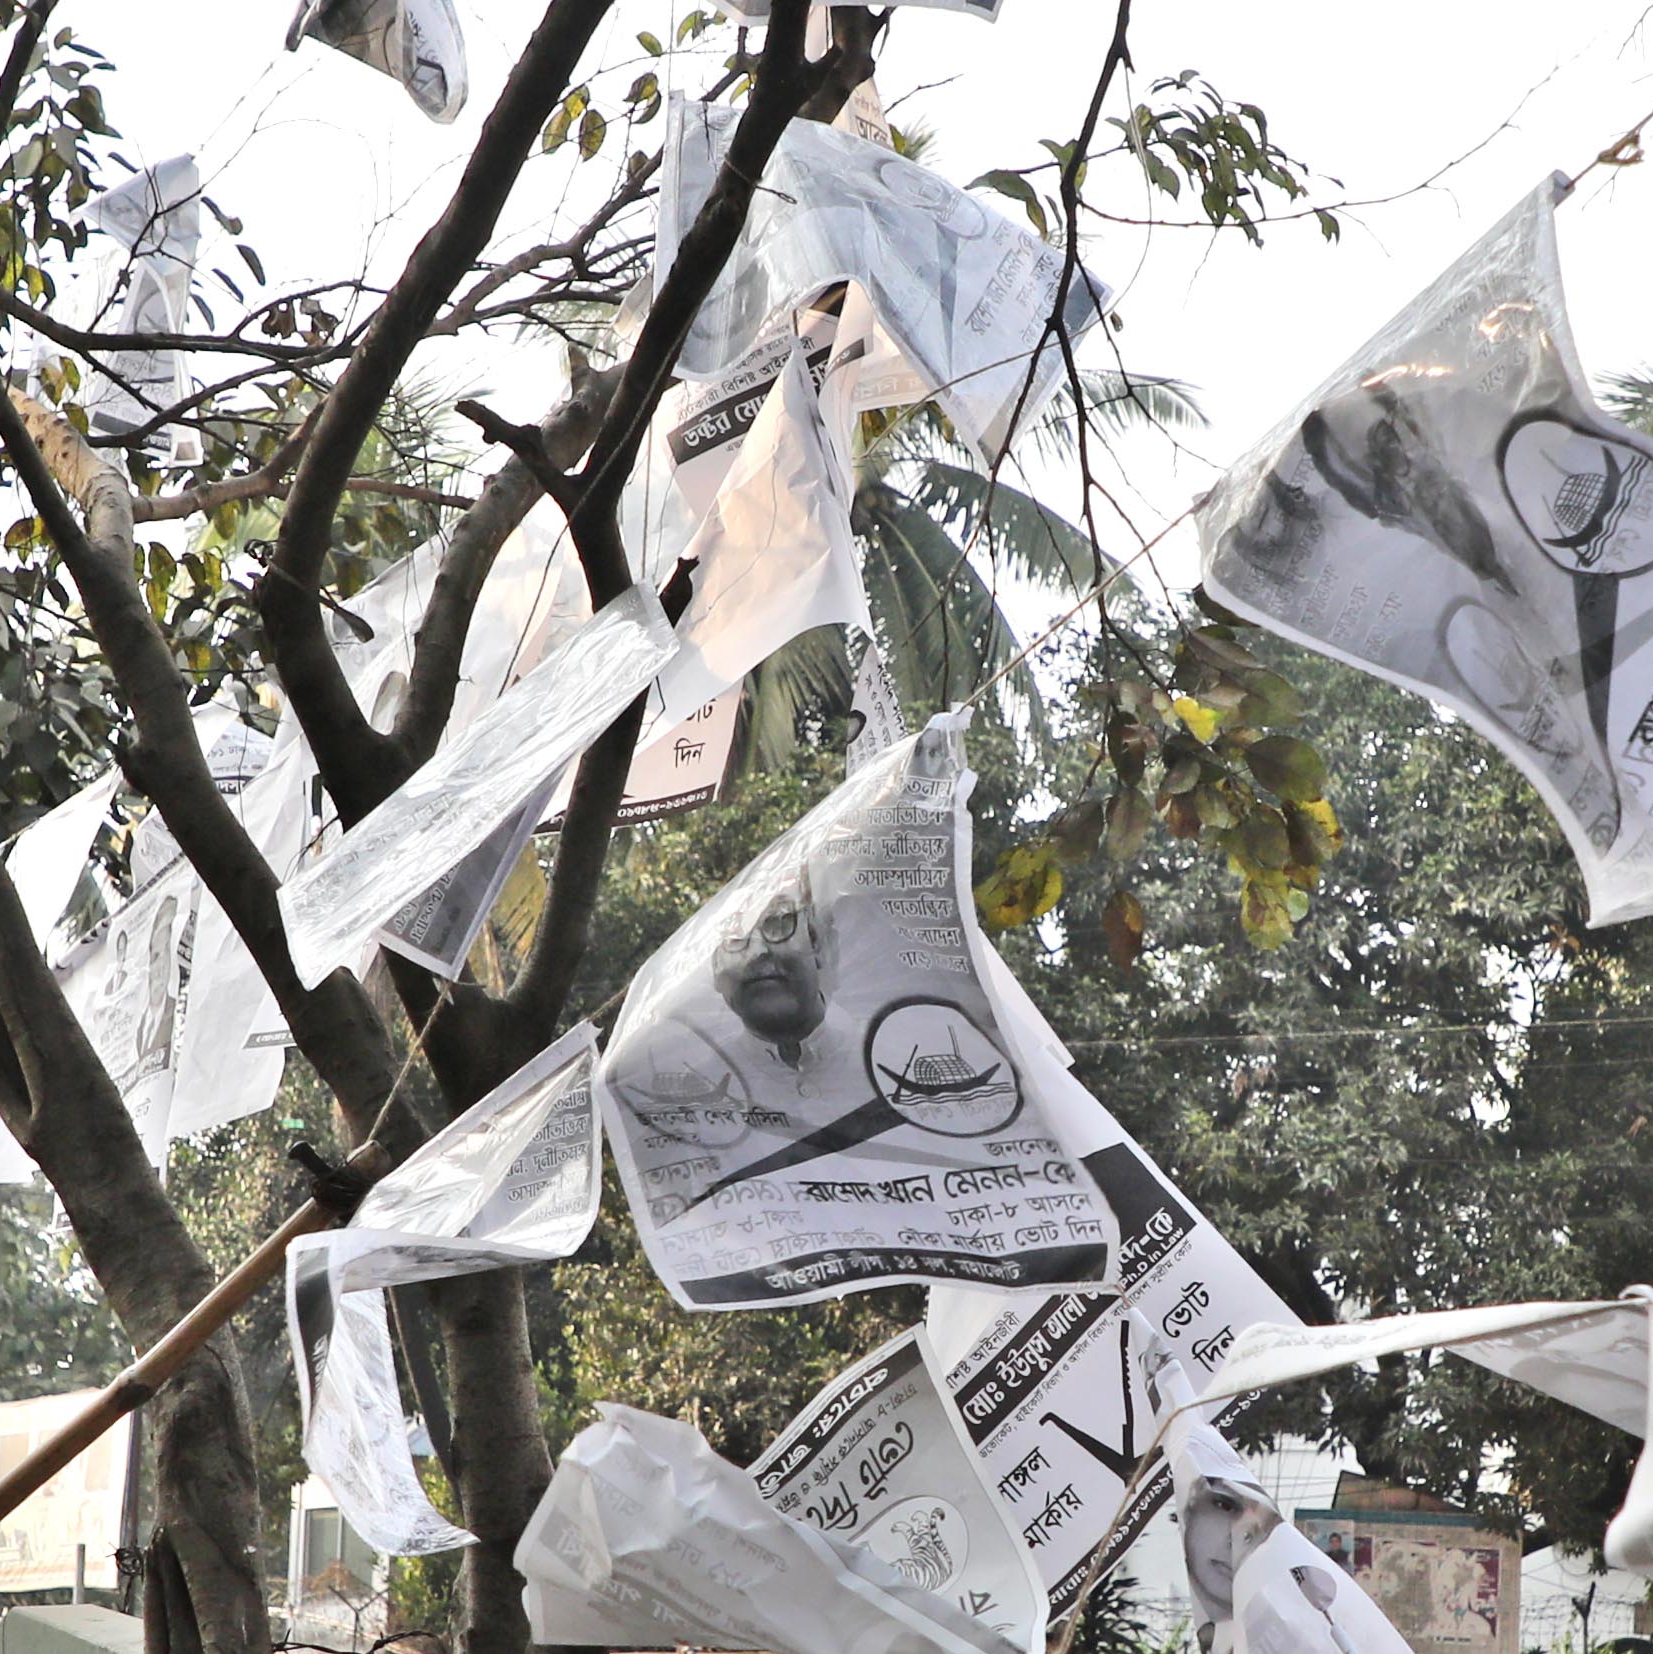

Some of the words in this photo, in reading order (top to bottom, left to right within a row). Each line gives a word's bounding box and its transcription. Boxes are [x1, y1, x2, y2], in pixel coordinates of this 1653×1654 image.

[674, 737, 707, 769] দিন
[897, 1225, 945, 1249] নৌকা
[947, 1229, 1008, 1254] মার্কায়
[1014, 1219, 1060, 1248] ভোট
[1065, 1215, 1104, 1242] দিন
[946, 1202, 1020, 1229] ঢাকা-৮
[1025, 1192, 1095, 1215] আসনে
[1120, 1258, 1149, 1290] Ph.D
[1160, 1227, 1186, 1251] Law
[1162, 1280, 1211, 1339] ভোট
[1191, 1324, 1236, 1373] দিন
[961, 1379, 1006, 1427] মোঃ
[859, 1420, 915, 1500] ভোট
[1022, 1483, 1085, 1549] মার্কায়
